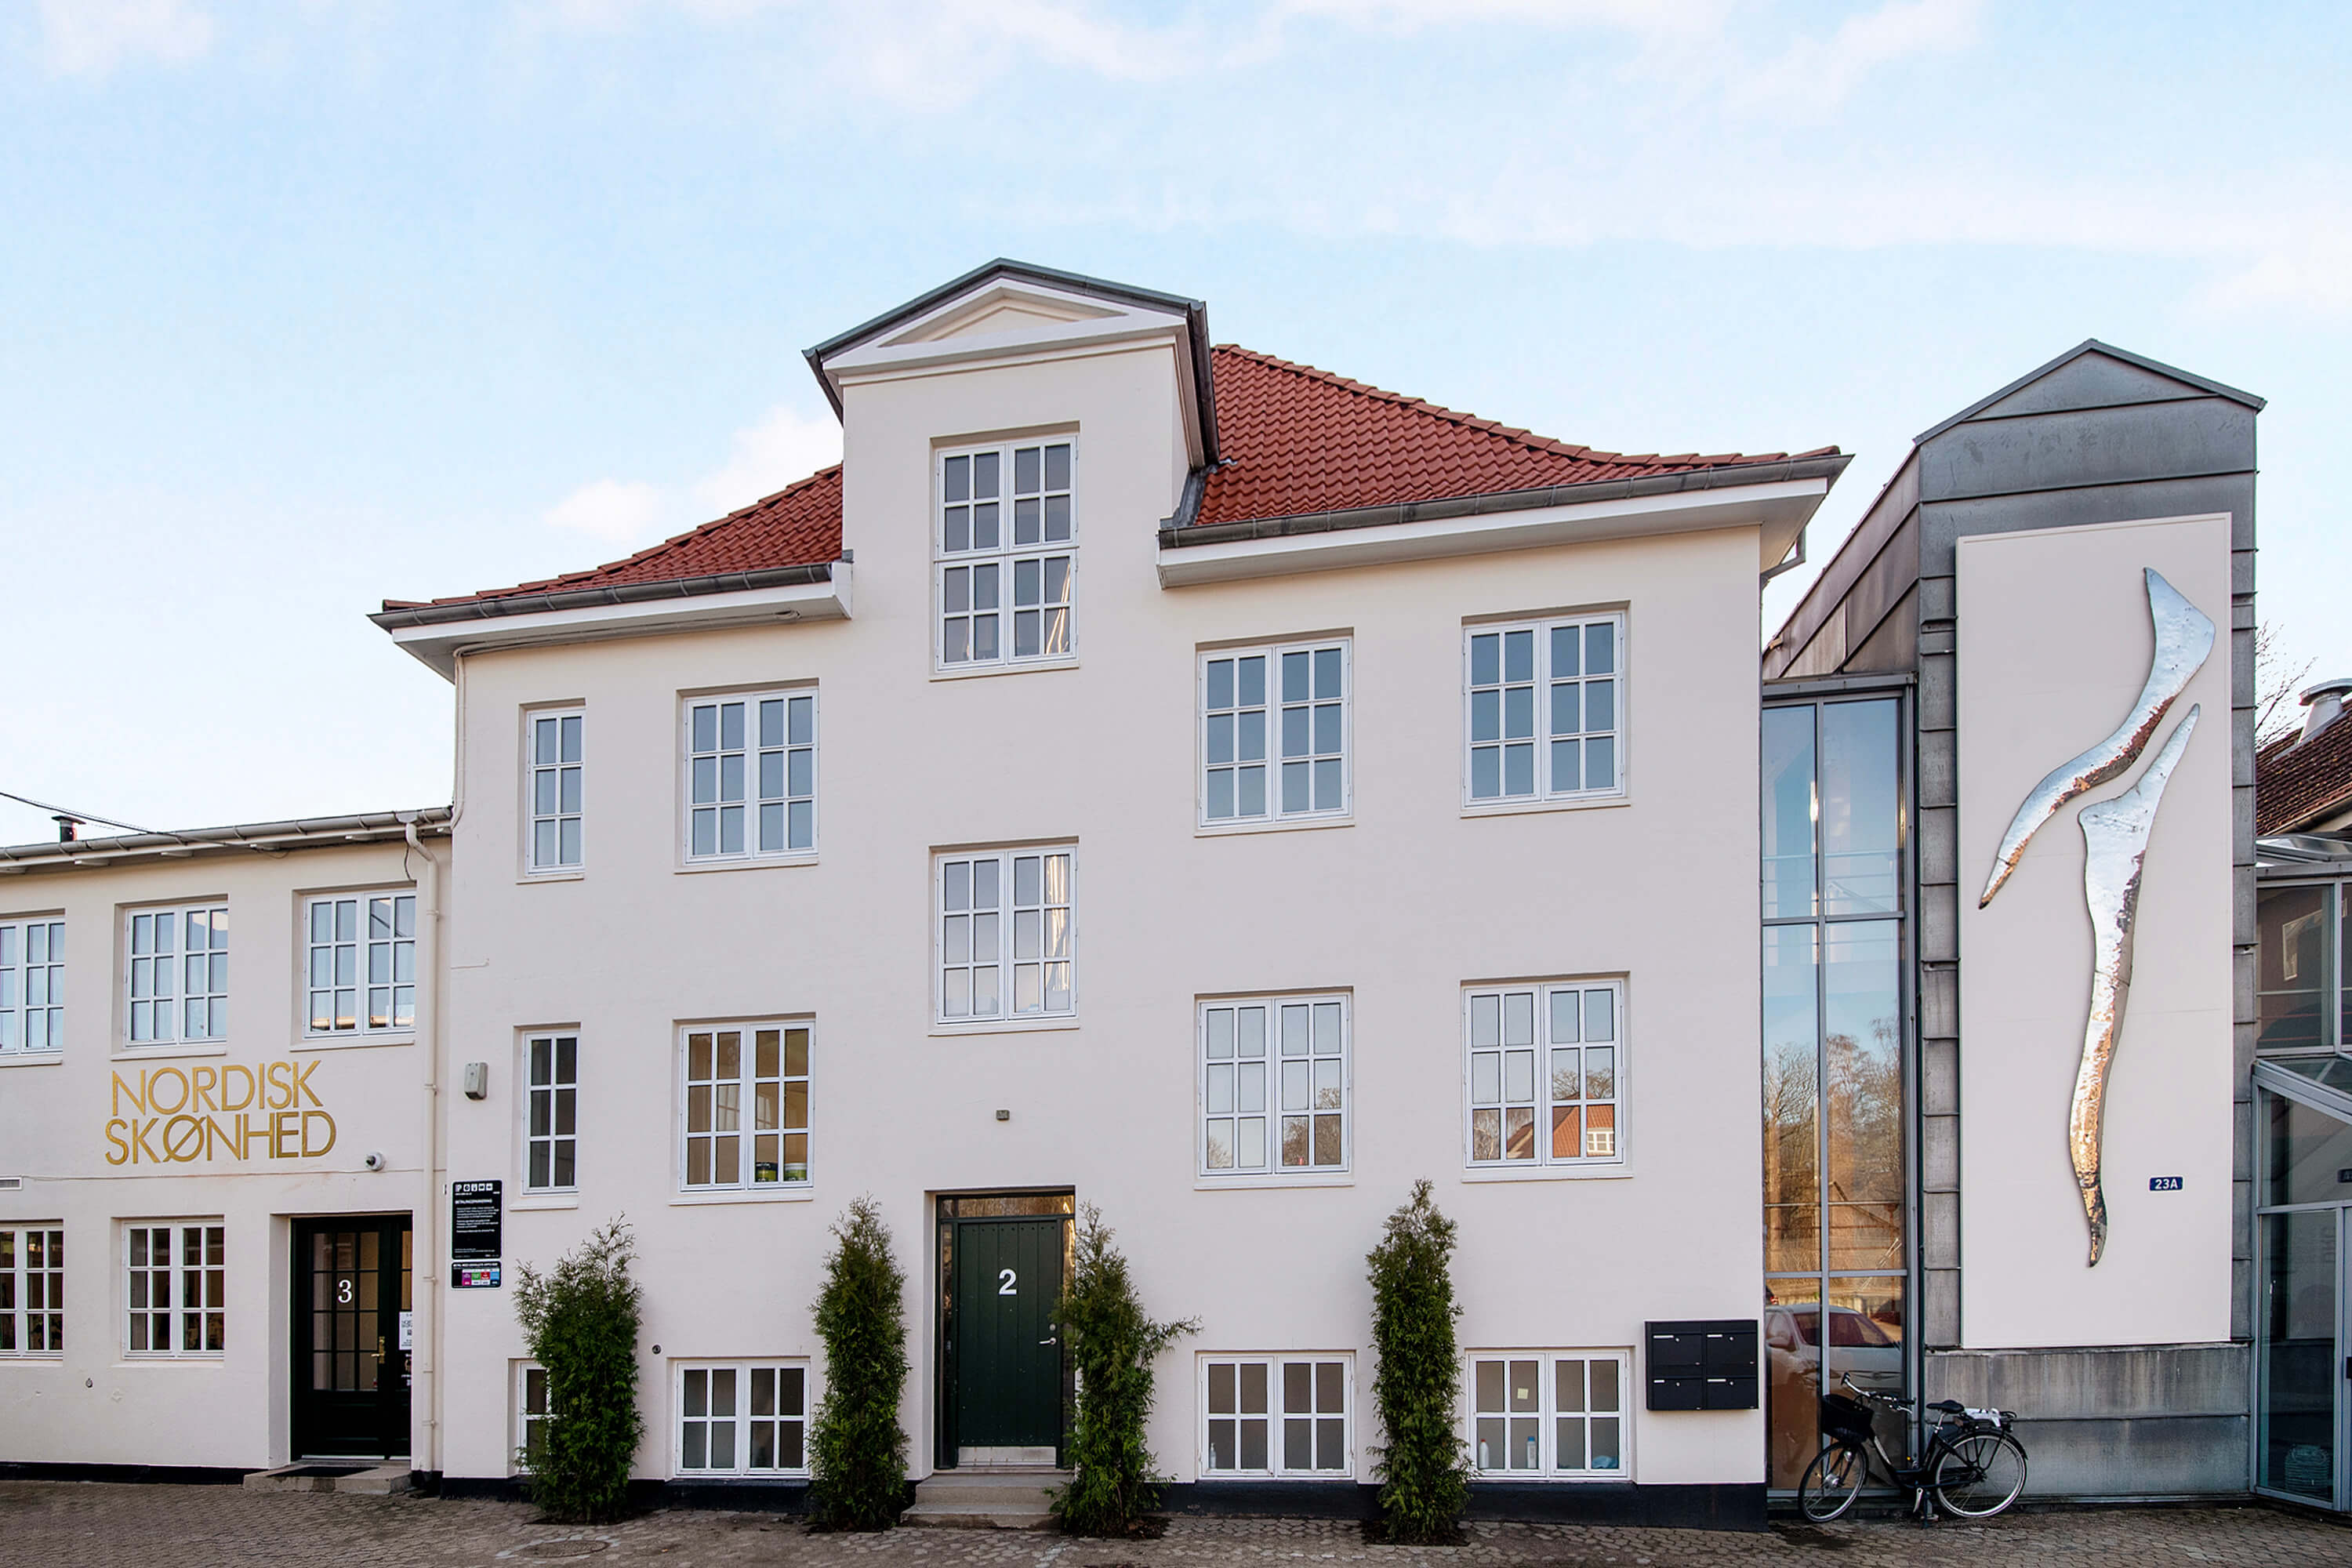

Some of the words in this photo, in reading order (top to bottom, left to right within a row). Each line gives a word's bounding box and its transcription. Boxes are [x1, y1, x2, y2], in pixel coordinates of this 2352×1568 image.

[112, 1060, 323, 1116] NORDISK
[105, 1110, 336, 1165] SKØNHED
[2154, 1178, 2178, 1189] 23A
[338, 1279, 352, 1303] 3
[999, 1269, 1017, 1295] 2
